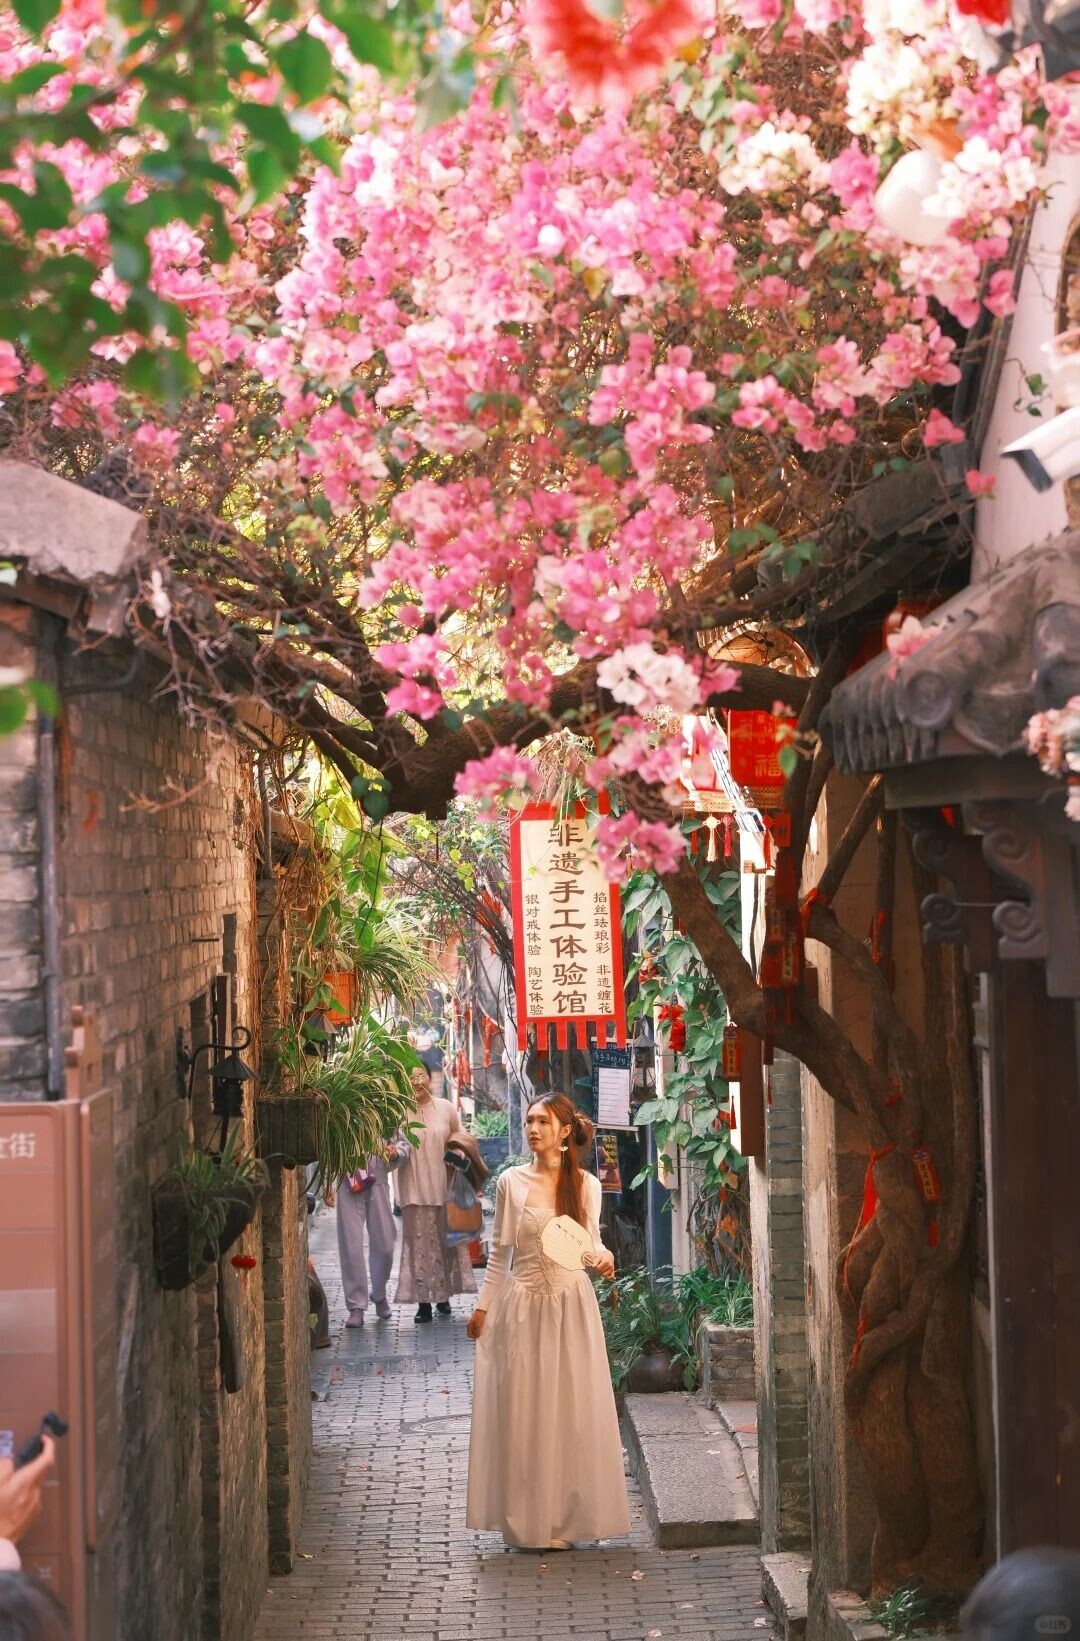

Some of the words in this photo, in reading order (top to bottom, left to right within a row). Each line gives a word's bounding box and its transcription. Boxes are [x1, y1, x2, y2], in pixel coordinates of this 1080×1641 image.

[525, 894, 541, 956] 银对戒体验
[548, 823, 588, 1014] 非遗手工体验馆
[593, 892, 610, 954] 掐丝珐琅彩
[528, 966, 544, 1016] 陶艺体验
[596, 964, 612, 1014] 非遗缠花
